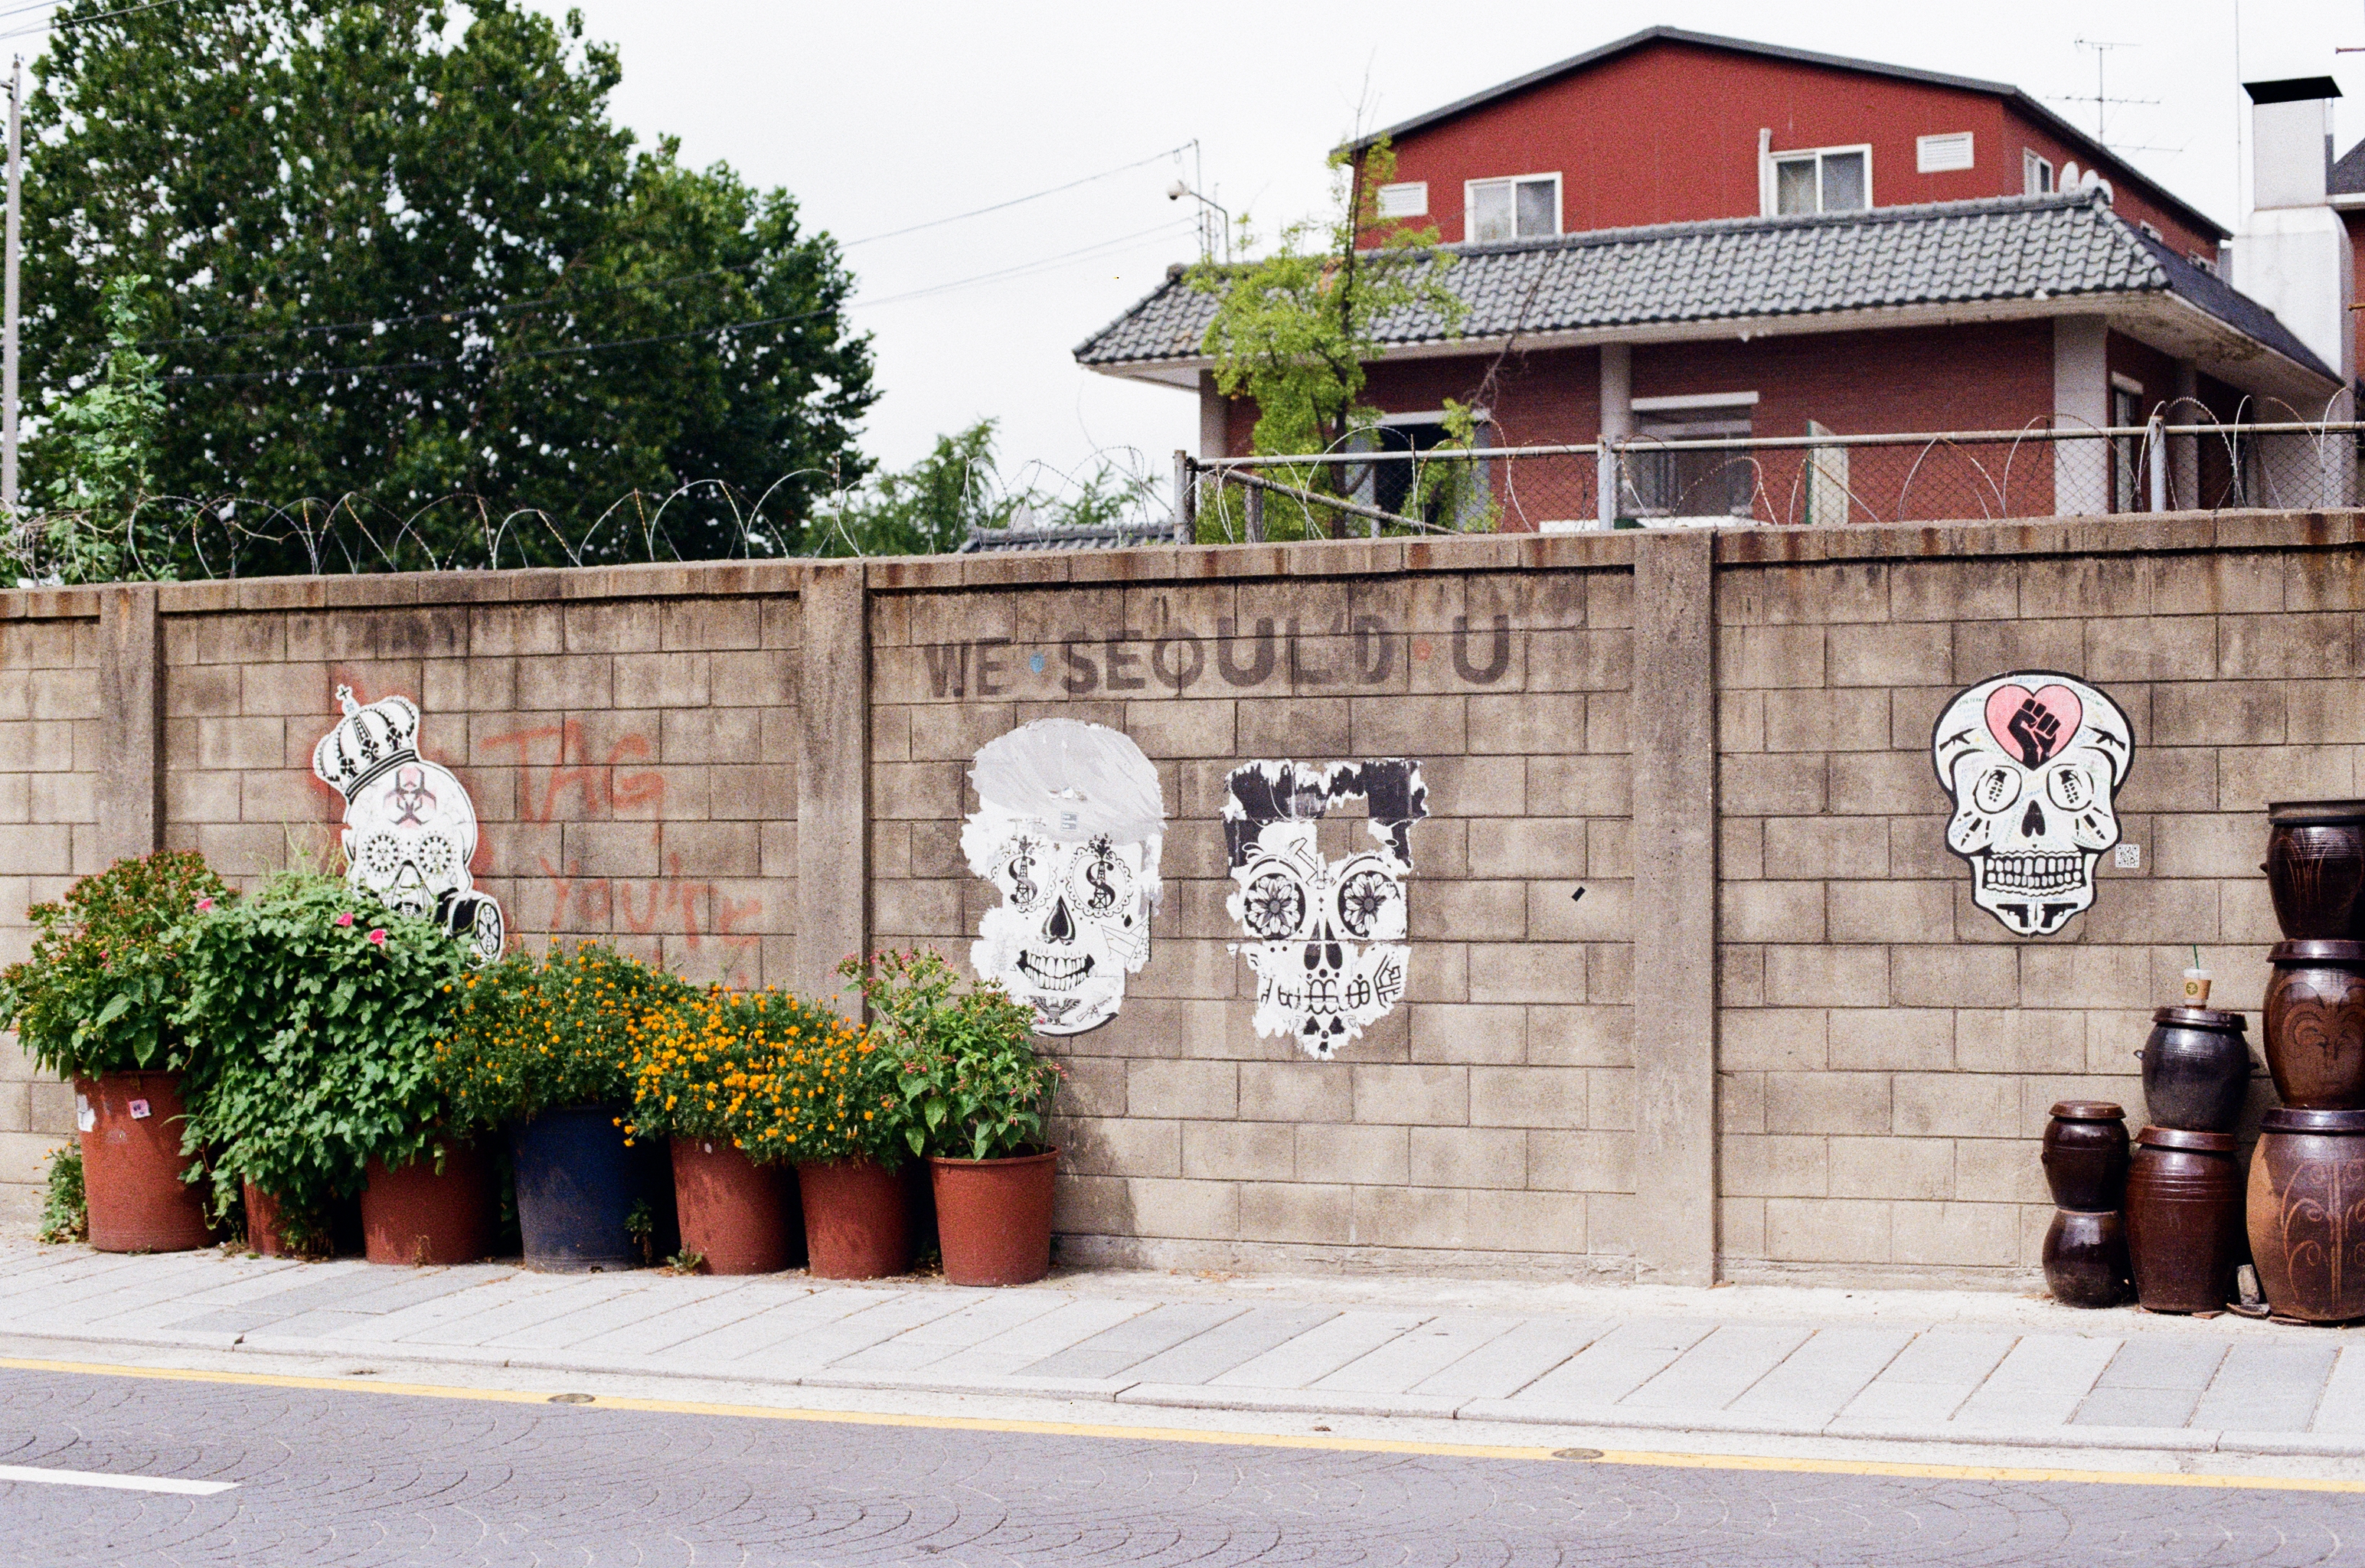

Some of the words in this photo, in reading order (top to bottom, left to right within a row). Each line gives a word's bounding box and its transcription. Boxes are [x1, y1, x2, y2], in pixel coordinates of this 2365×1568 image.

[923, 637, 1011, 697] WE
[1452, 613, 1511, 684] U
[479, 718, 665, 830] TAG
